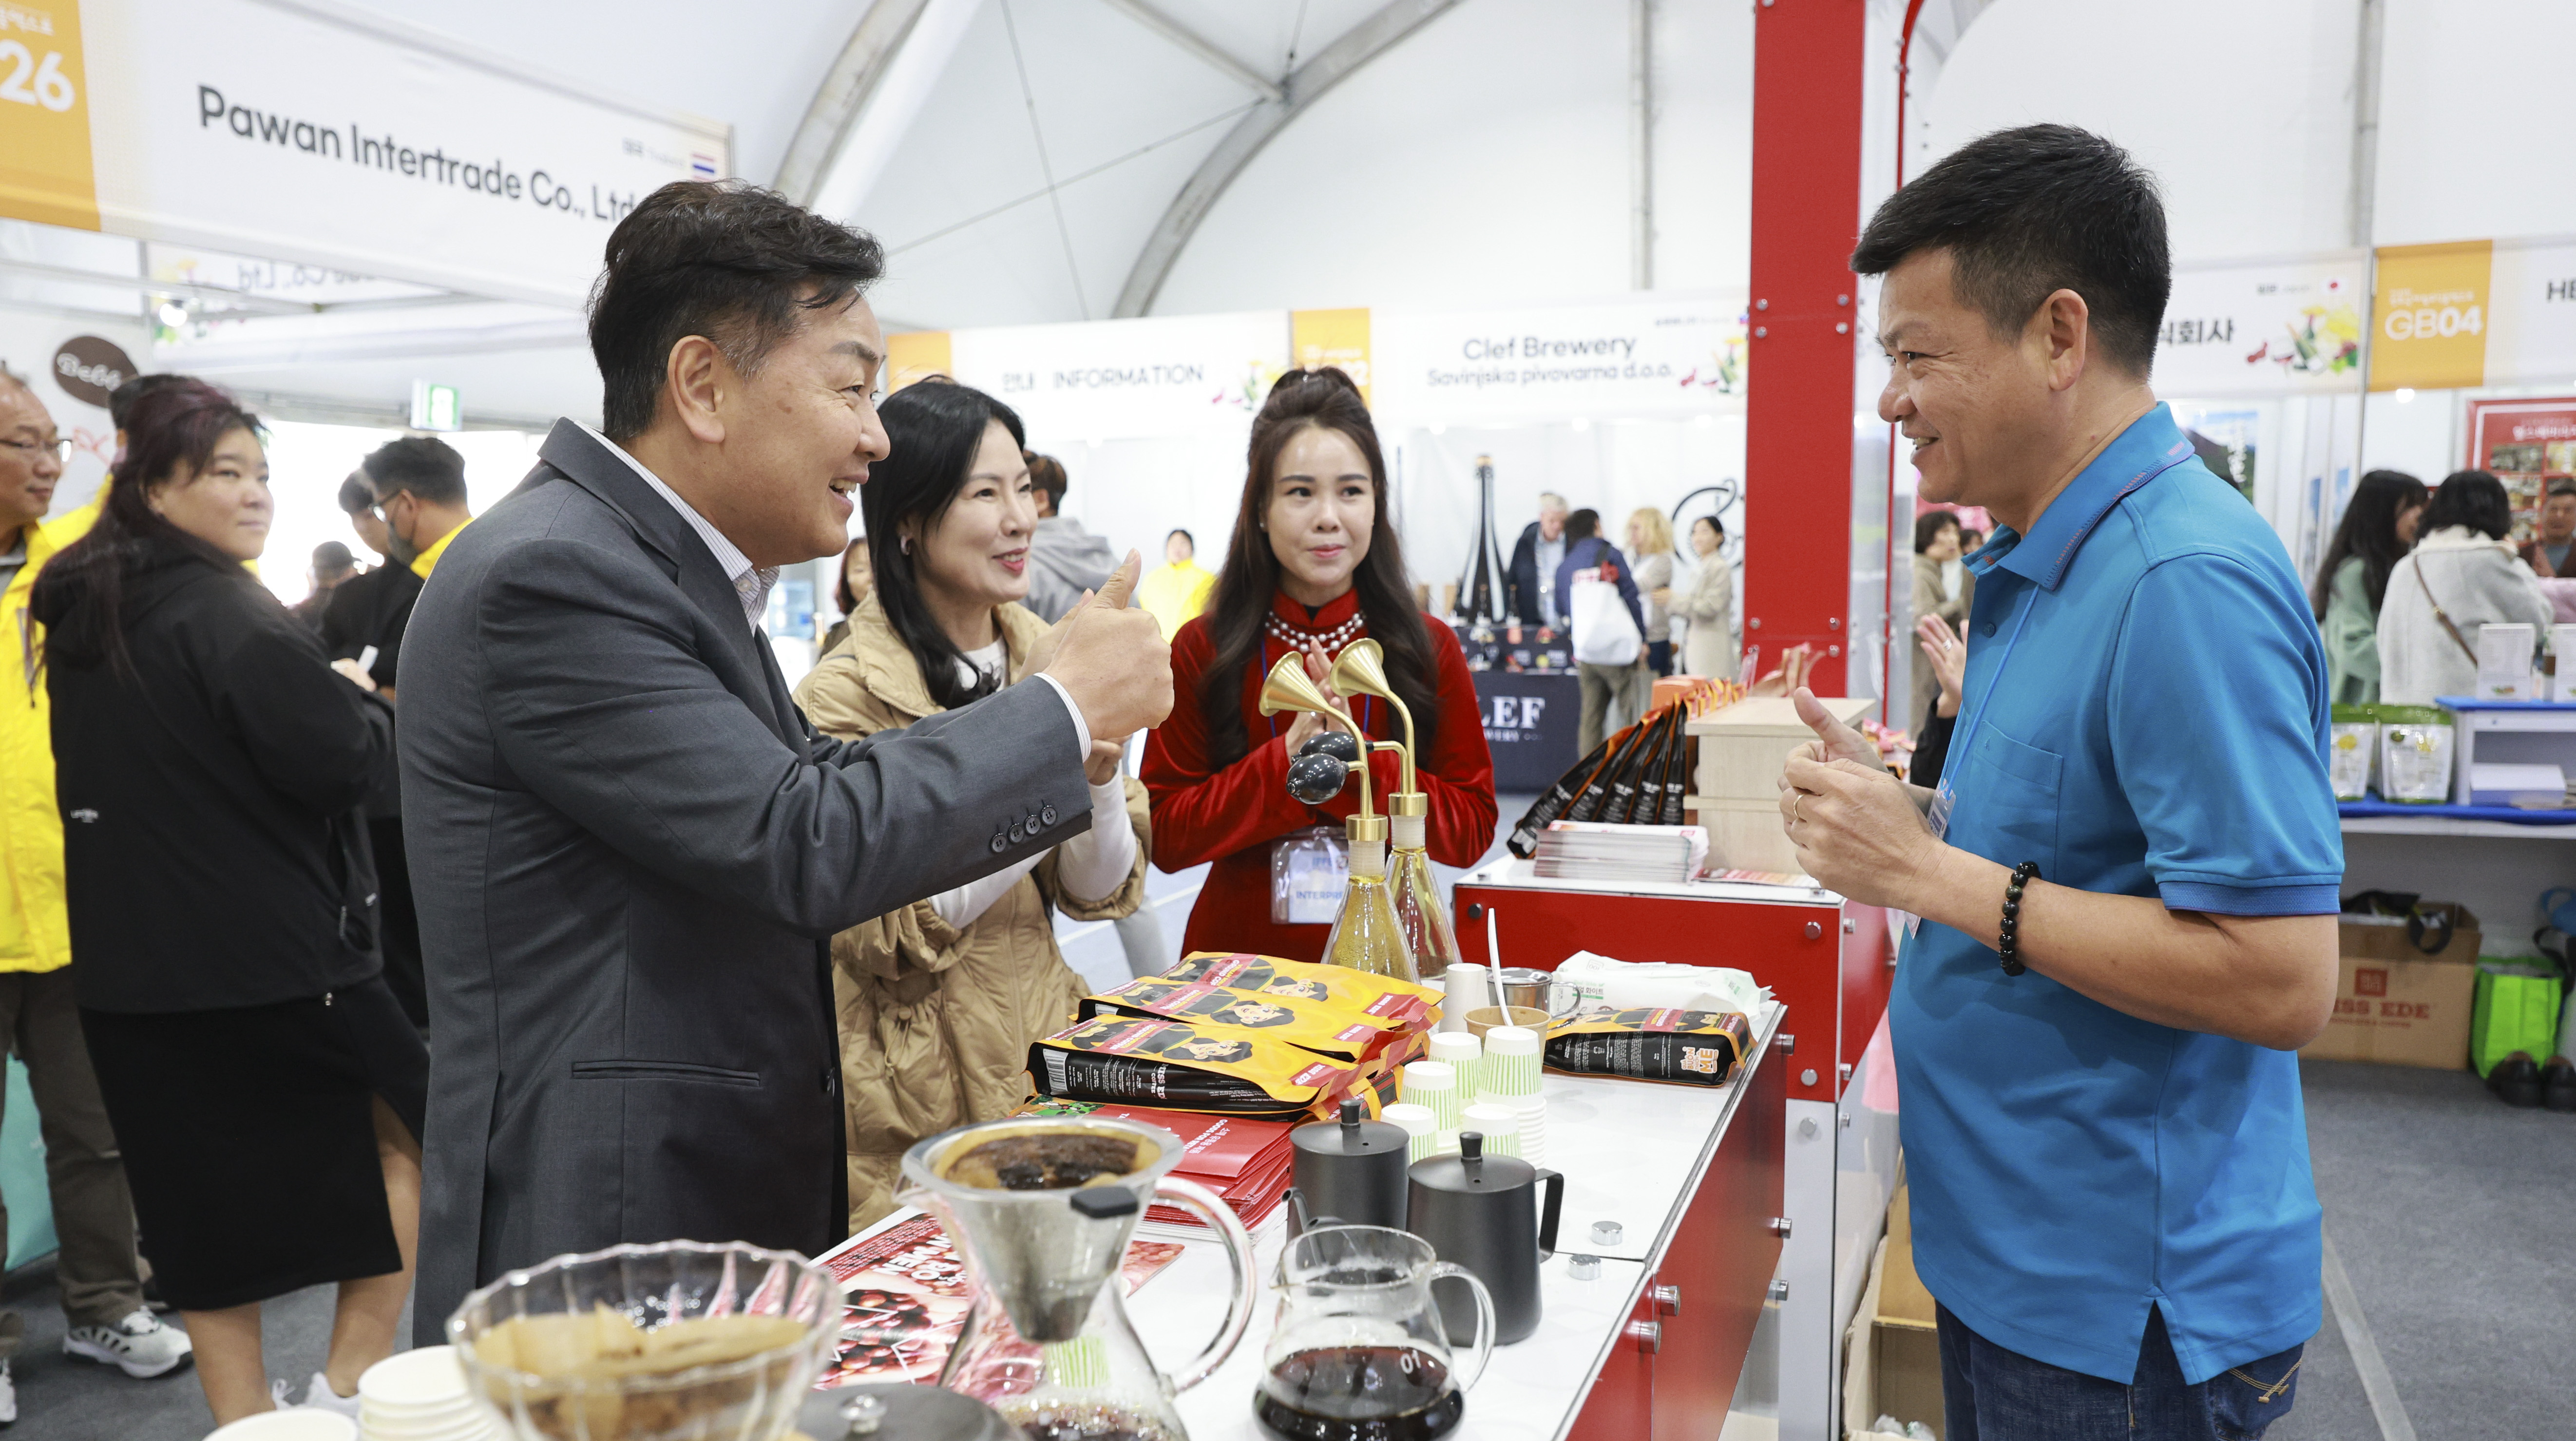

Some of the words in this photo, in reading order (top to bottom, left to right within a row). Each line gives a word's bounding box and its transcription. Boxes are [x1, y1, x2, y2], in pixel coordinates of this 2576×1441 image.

[0, 39, 75, 112] 26
[197, 84, 341, 159] Pawan
[352, 124, 521, 199] Intertrade
[531, 171, 585, 219] Co.,
[2385, 305, 2483, 341] GB04
[1463, 337, 1516, 360] Clef
[1524, 336, 1637, 358] Brewery
[1053, 364, 1203, 389] INFORMATION
[1428, 367, 1517, 389] Savinjska
[1522, 365, 1618, 386] pivovarna
[1624, 360, 1676, 380] d.o.o.
[1478, 696, 1546, 729] EF
[2332, 999, 2370, 1015] ISS
[2379, 1002, 2430, 1020] EDE
[1295, 1073, 1312, 1085] EDE
[1308, 1064, 1326, 1075] MISS
[1156, 1086, 1167, 1100] ED
[1197, 1133, 1211, 1141] FOR
[1206, 1119, 1228, 1133] GOODS
[1183, 1139, 1200, 1152] RETA
[873, 1246, 940, 1275] MEN
